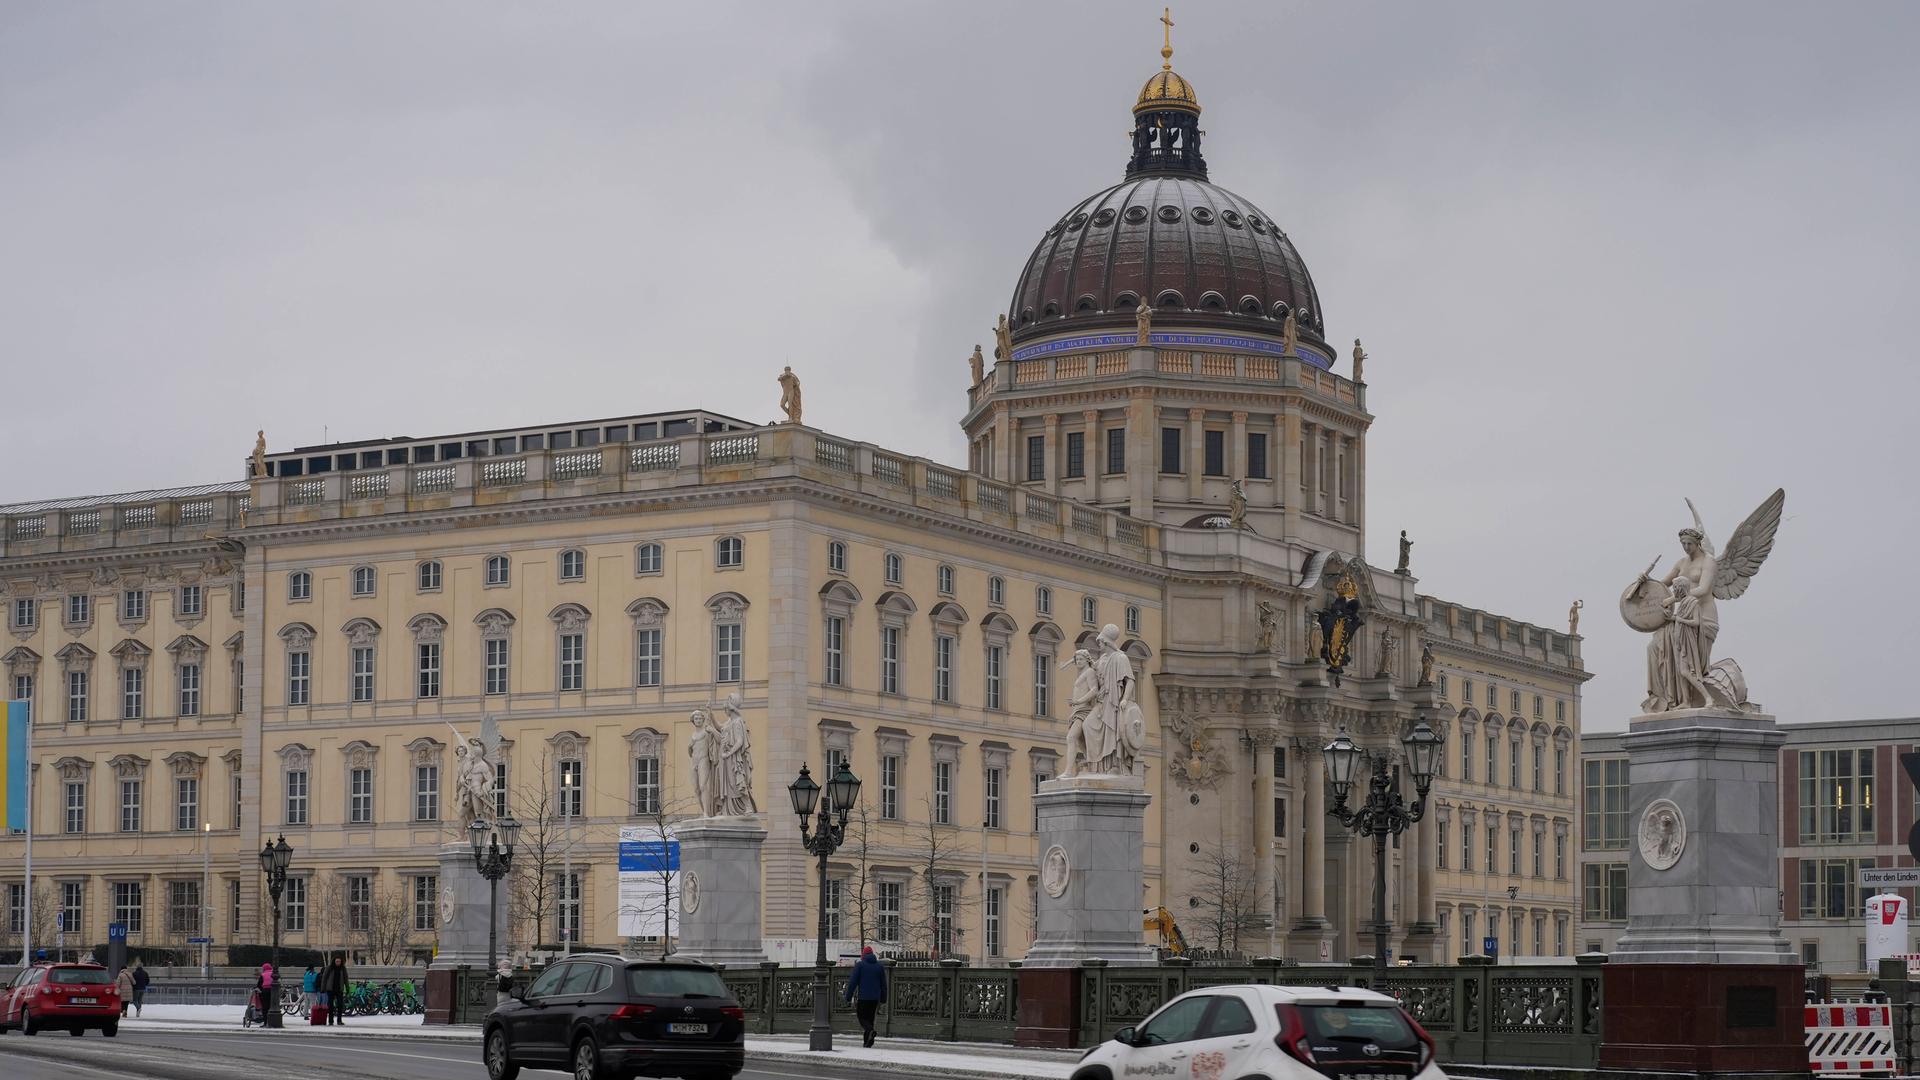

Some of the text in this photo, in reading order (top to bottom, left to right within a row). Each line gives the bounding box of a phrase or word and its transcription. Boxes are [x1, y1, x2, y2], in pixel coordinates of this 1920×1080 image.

[1864, 872, 1918, 882] Unter den Linden
[110, 927, 116, 936] U
[119, 927, 125, 936] U
[1485, 941, 1492, 949] U
